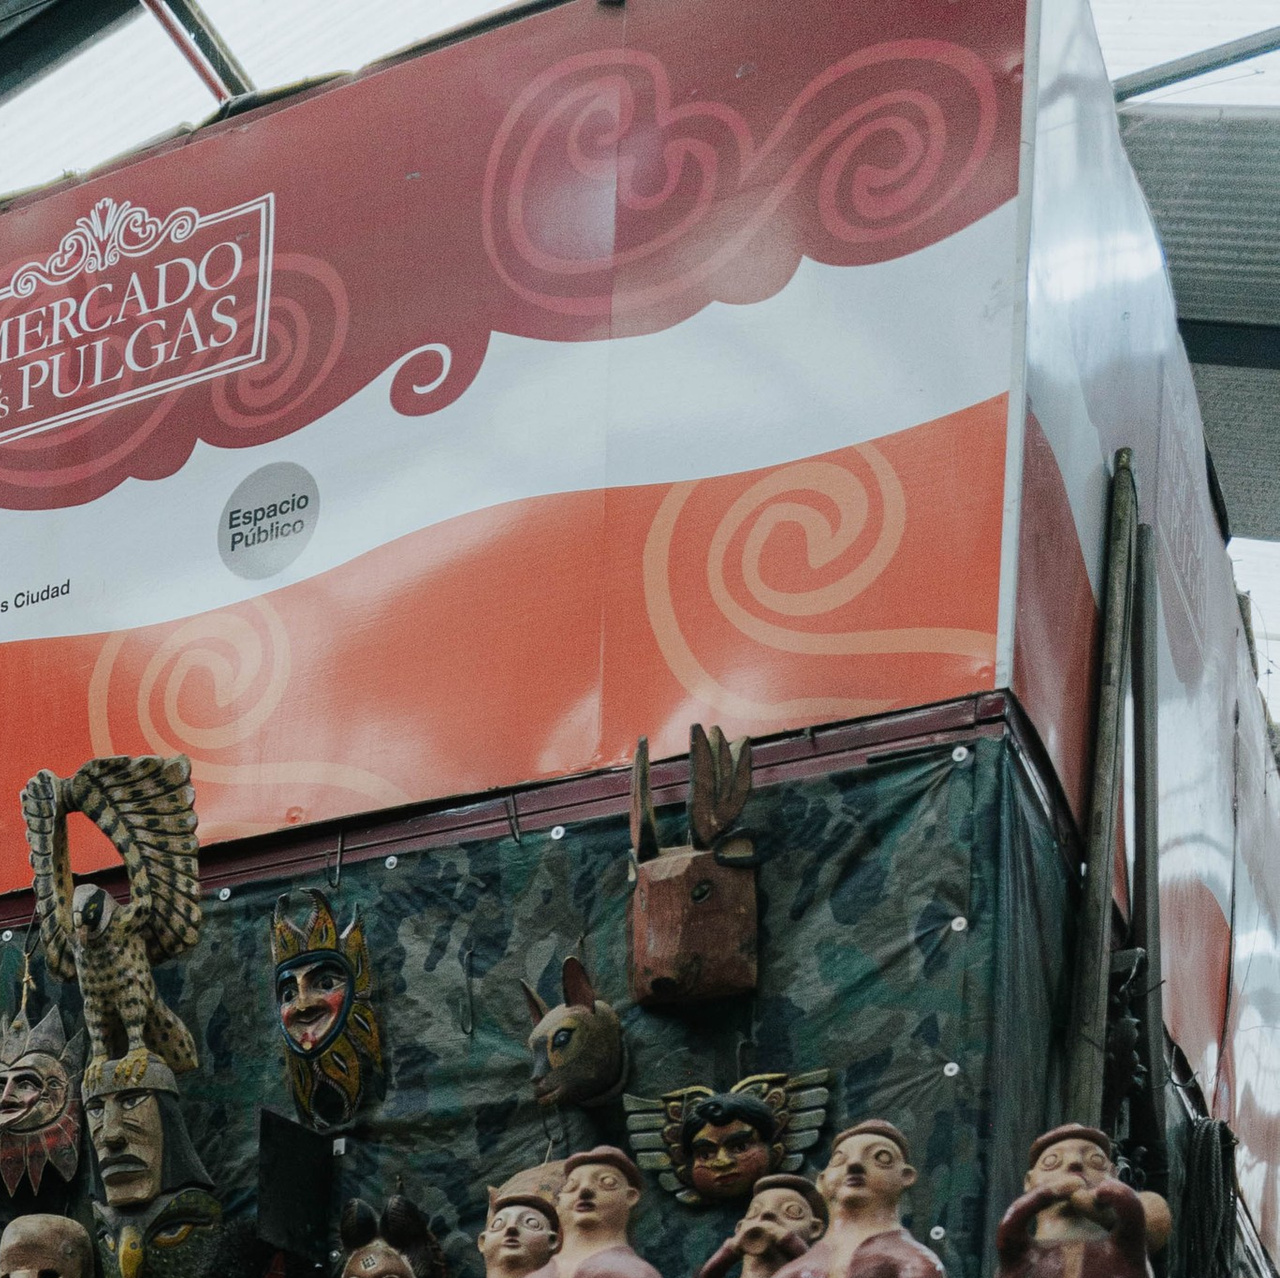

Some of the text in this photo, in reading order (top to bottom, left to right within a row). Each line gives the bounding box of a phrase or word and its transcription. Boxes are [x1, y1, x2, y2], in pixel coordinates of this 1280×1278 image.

[17, 294, 238, 413] PULGAS
[228, 493, 310, 531] Espacio
[230, 519, 305, 552] Público
[13, 578, 71, 609] Ciudad
